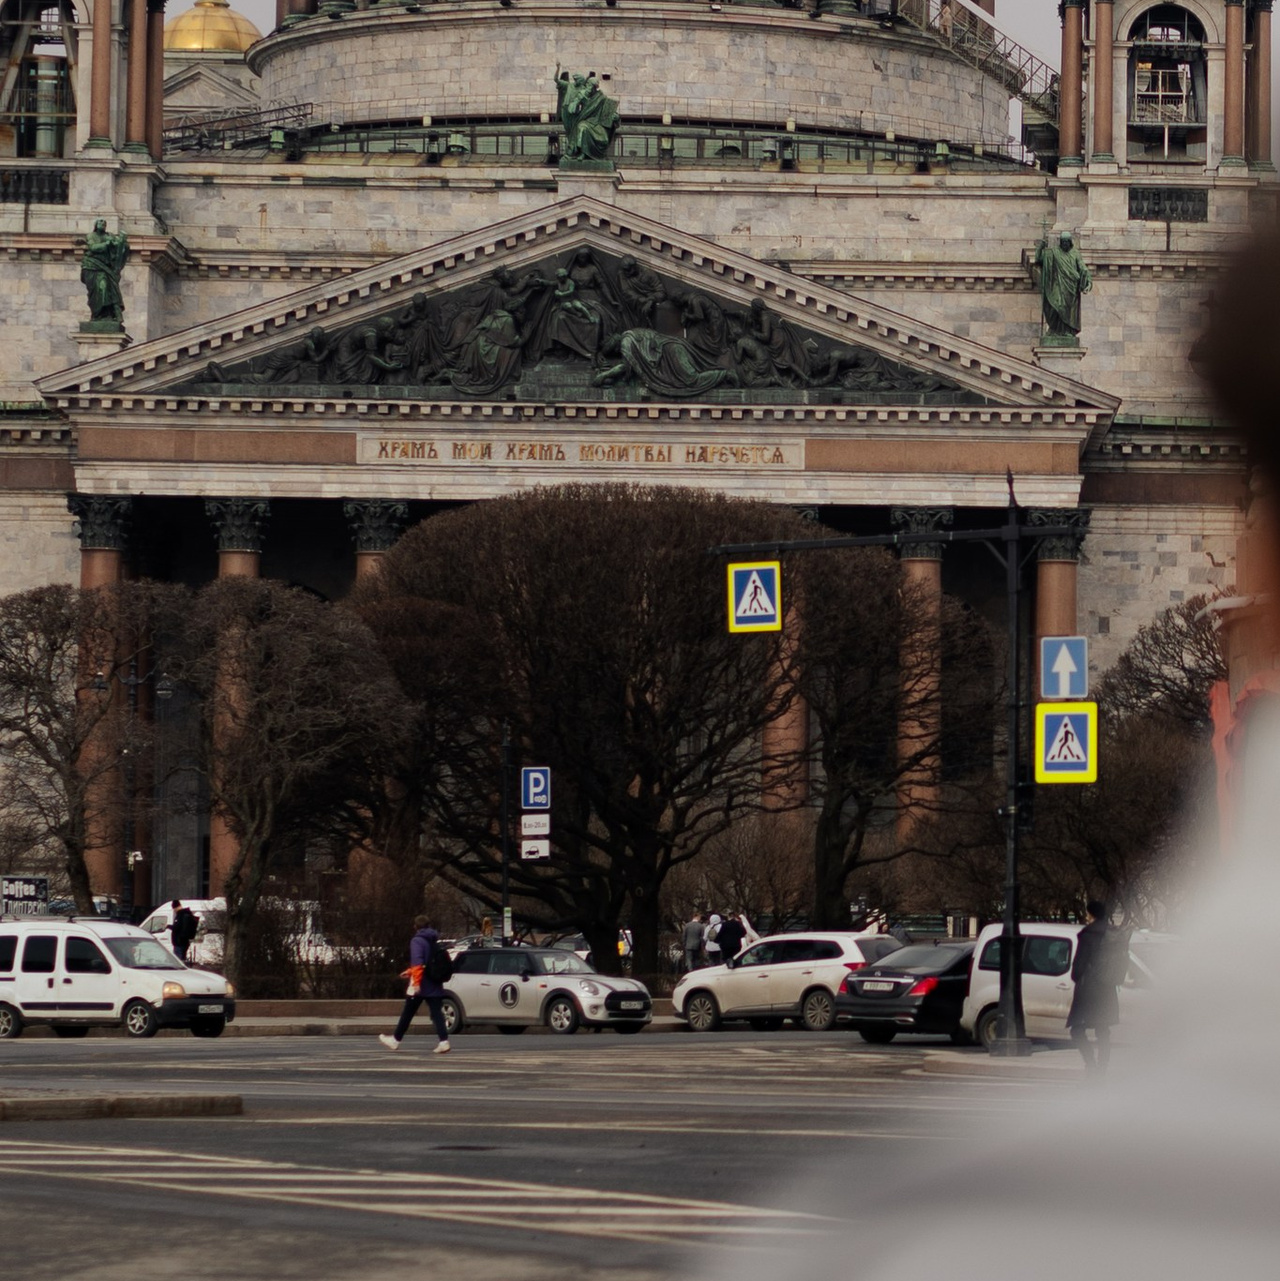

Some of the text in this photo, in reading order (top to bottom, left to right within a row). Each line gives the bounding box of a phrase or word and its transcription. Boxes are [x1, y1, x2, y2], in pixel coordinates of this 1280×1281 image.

[377, 441, 438, 459] ХРАМЪ
[506, 443, 566, 461] ХРАМЪ
[529, 772, 545, 803] P
[3, 881, 35, 898] Coffee
[504, 986, 514, 1004] 1
